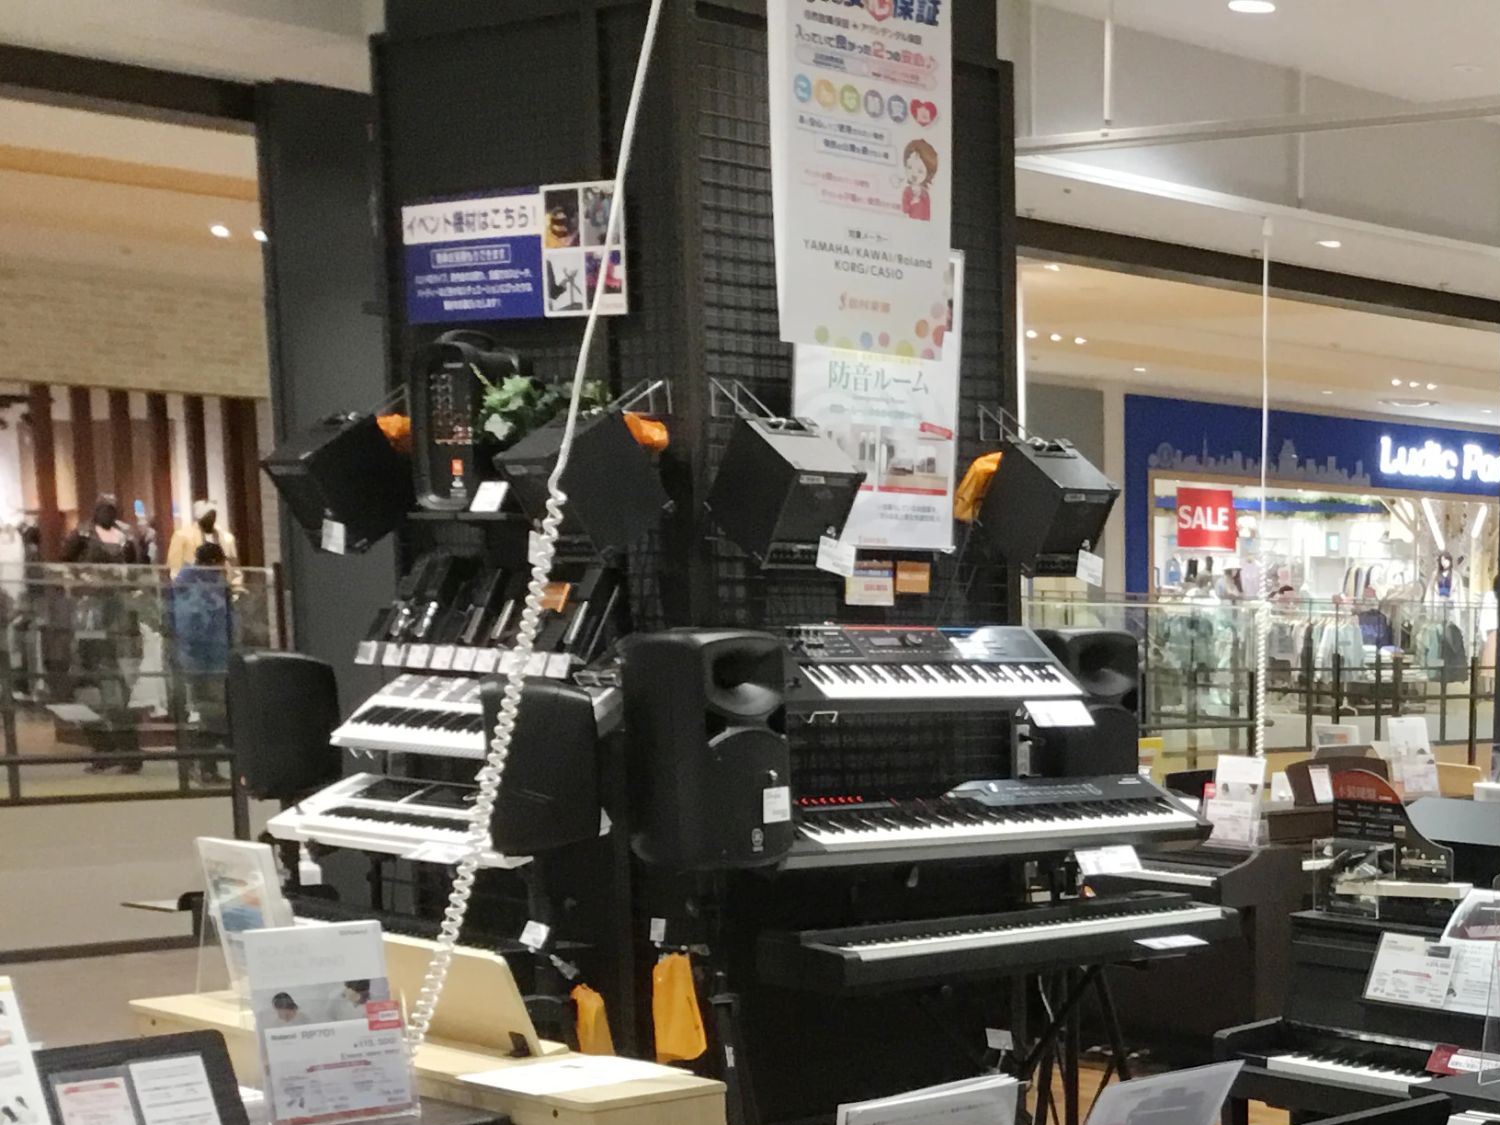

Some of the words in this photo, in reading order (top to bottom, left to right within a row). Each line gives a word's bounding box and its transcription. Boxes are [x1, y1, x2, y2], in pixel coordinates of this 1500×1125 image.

[803, 239, 933, 269] YAMAHA/KAWAI/Roland
[834, 260, 903, 280] KORG/CASIO
[828, 360, 930, 395] 防音ルーム
[1380, 435, 1459, 480] Ludic
[1177, 505, 1229, 532] SALE
